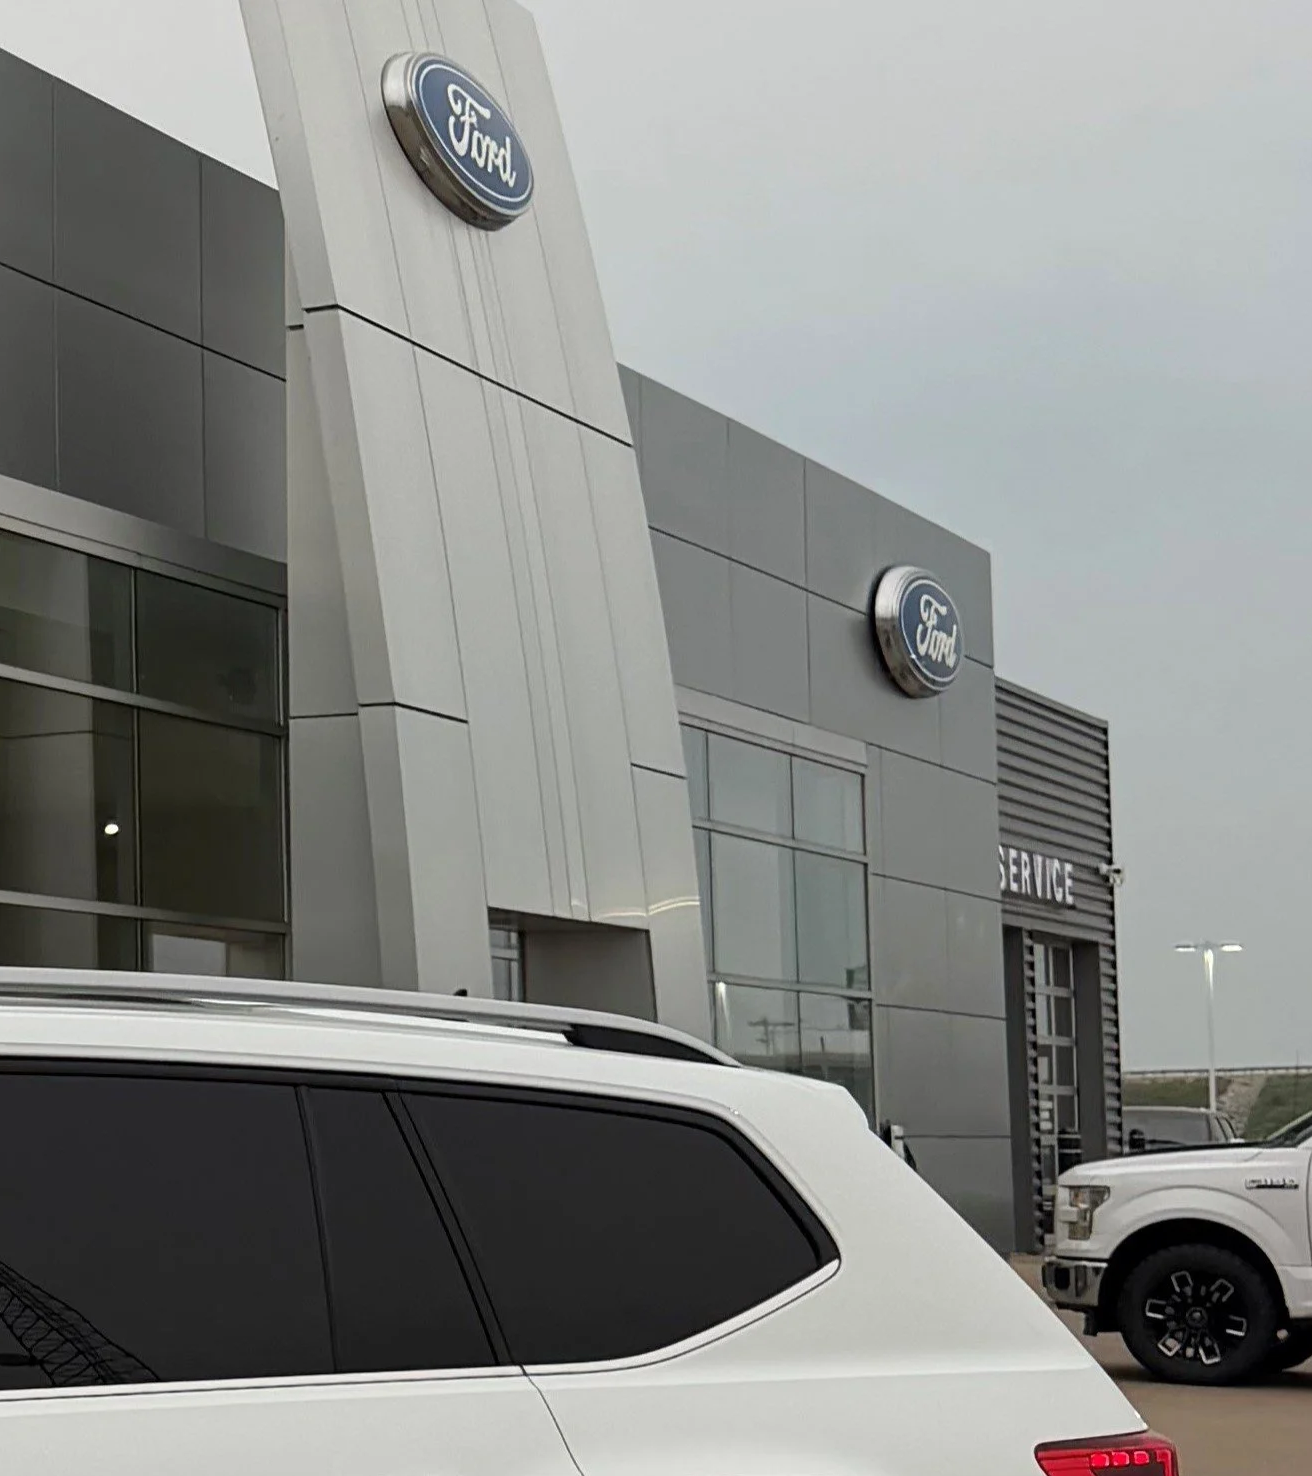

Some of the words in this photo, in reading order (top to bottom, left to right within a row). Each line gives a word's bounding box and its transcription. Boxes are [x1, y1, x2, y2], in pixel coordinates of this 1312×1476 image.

[447, 83, 516, 188] Ford
[916, 594, 958, 669] Ford
[998, 844, 1074, 905] SERVICE
